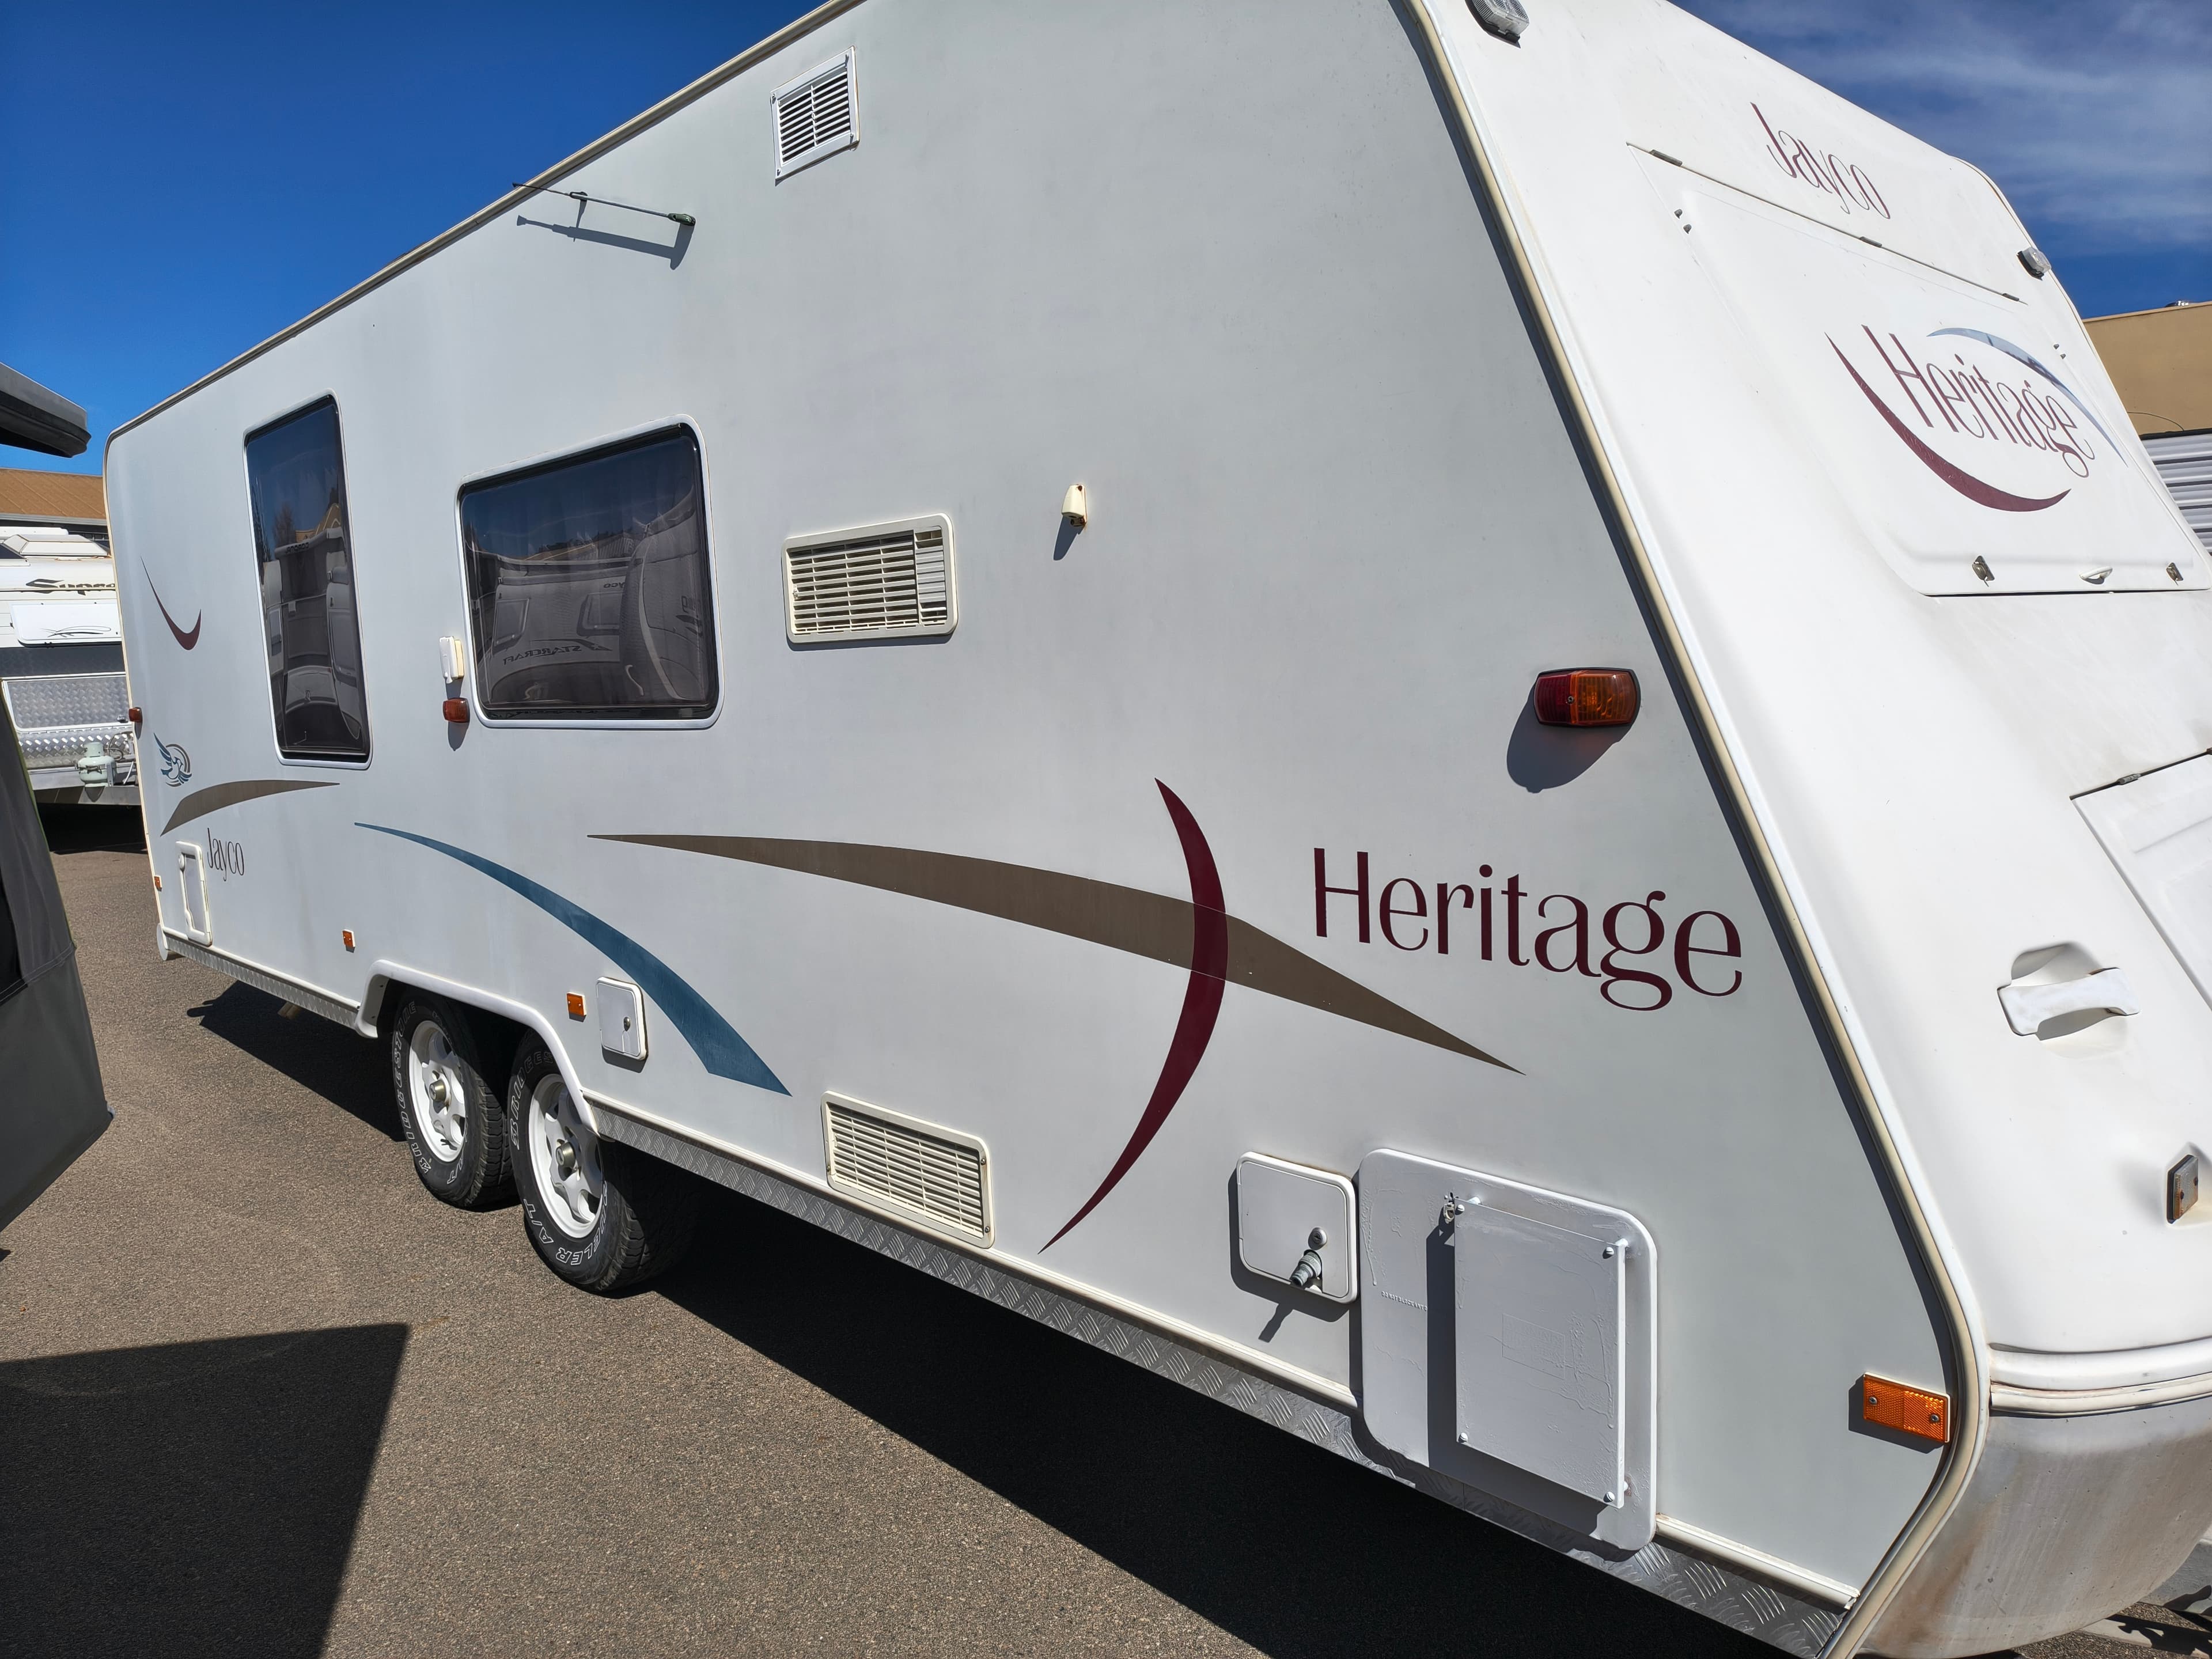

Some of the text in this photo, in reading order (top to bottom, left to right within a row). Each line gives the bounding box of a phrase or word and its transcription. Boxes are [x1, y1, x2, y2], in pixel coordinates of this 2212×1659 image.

[1749, 101, 1892, 220] Jayco
[1861, 324, 2096, 479] Heritage
[207, 827, 245, 882] Jayco
[1314, 847, 1743, 1012] Heritage
[393, 1000, 433, 1175] BRIDGESTONE
[510, 1050, 554, 1151] BRIDGES
[522, 1198, 555, 1244] A/T
